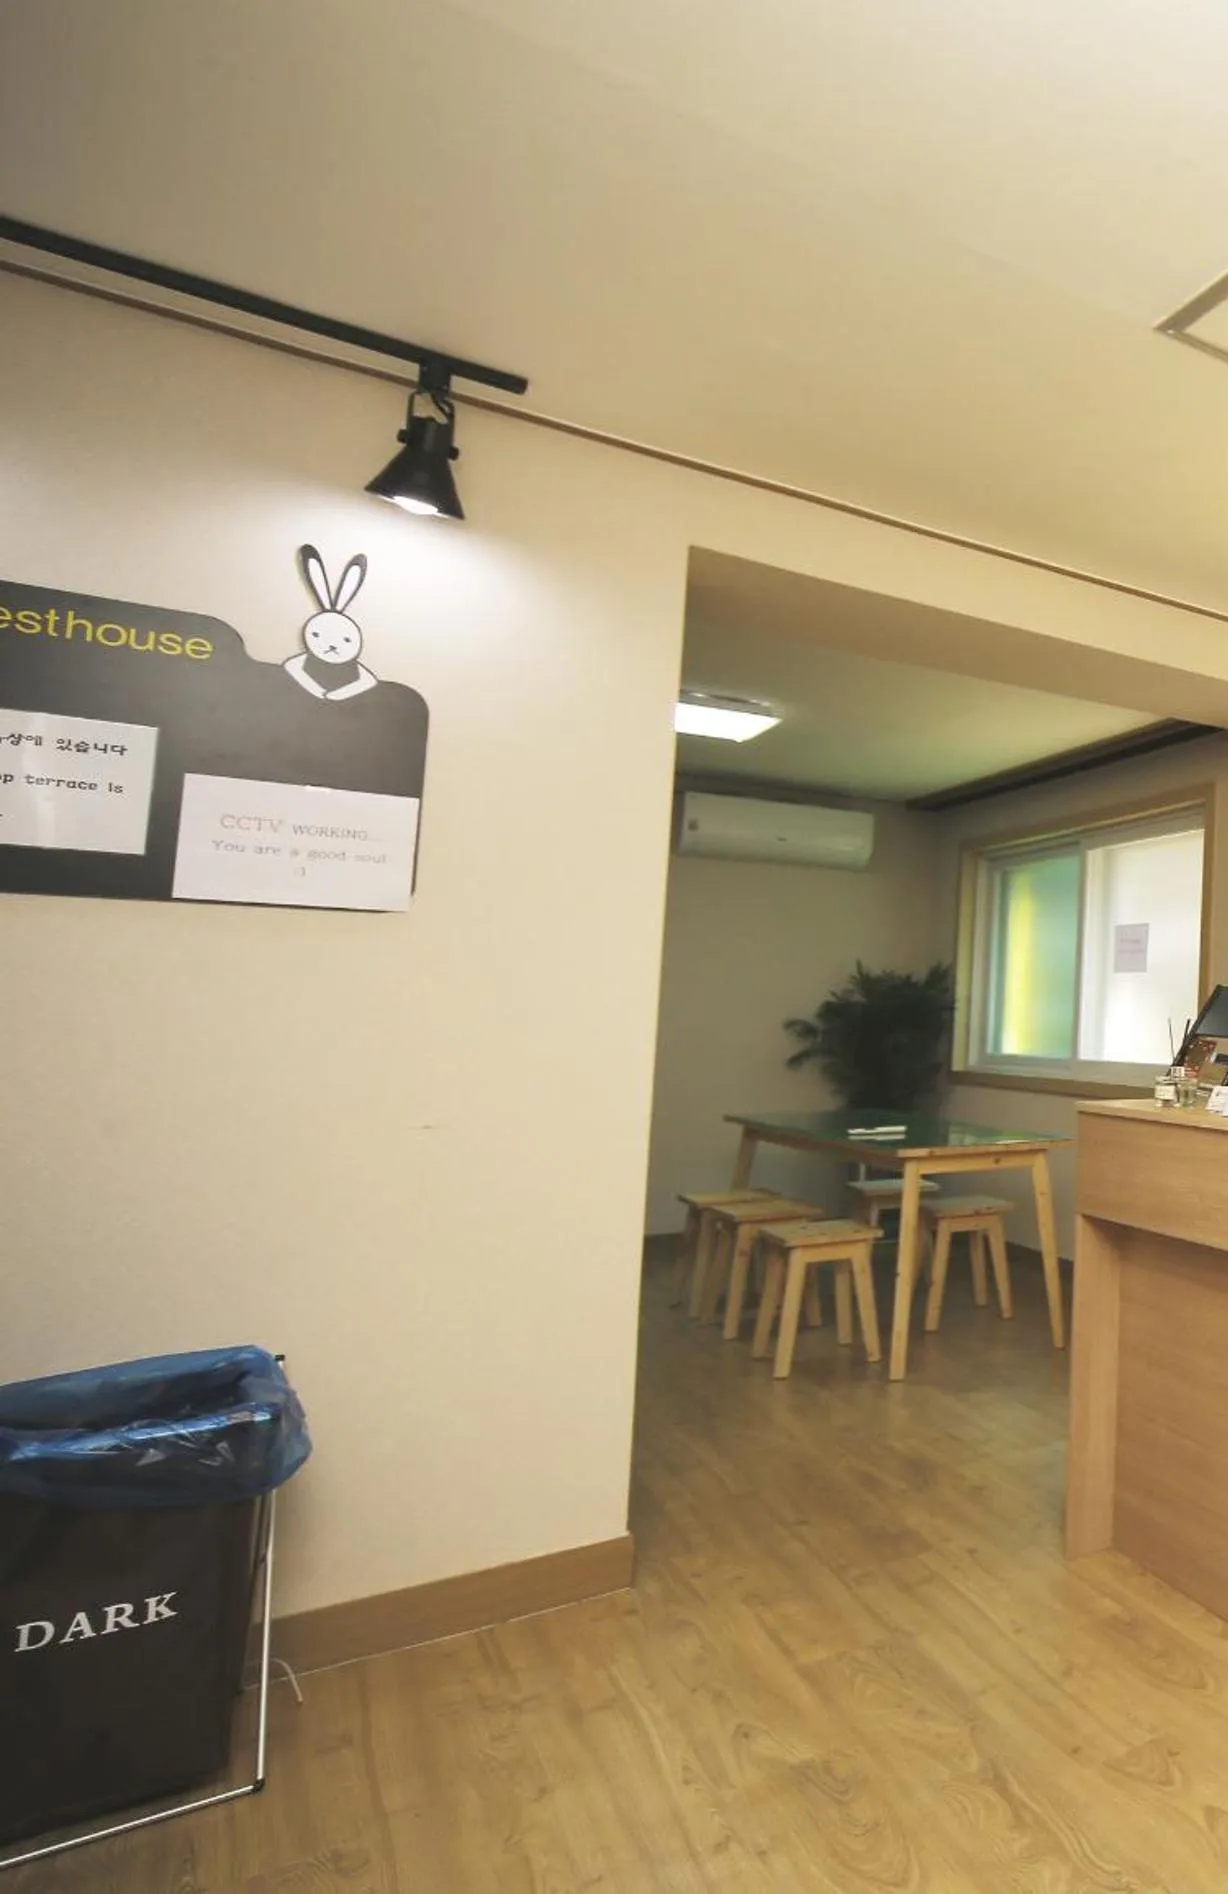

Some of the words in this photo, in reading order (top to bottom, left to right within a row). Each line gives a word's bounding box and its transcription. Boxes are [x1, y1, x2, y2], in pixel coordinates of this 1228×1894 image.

[56, 738, 128, 756] 있습니다
[0, 773, 14, 784] p
[24, 774, 98, 791] terrace
[107, 782, 124, 793] is
[219, 814, 284, 834] CCTV
[212, 840, 246, 854] You
[253, 844, 282, 856] are
[306, 849, 347, 862] good
[14, 1591, 178, 1652] DARK
